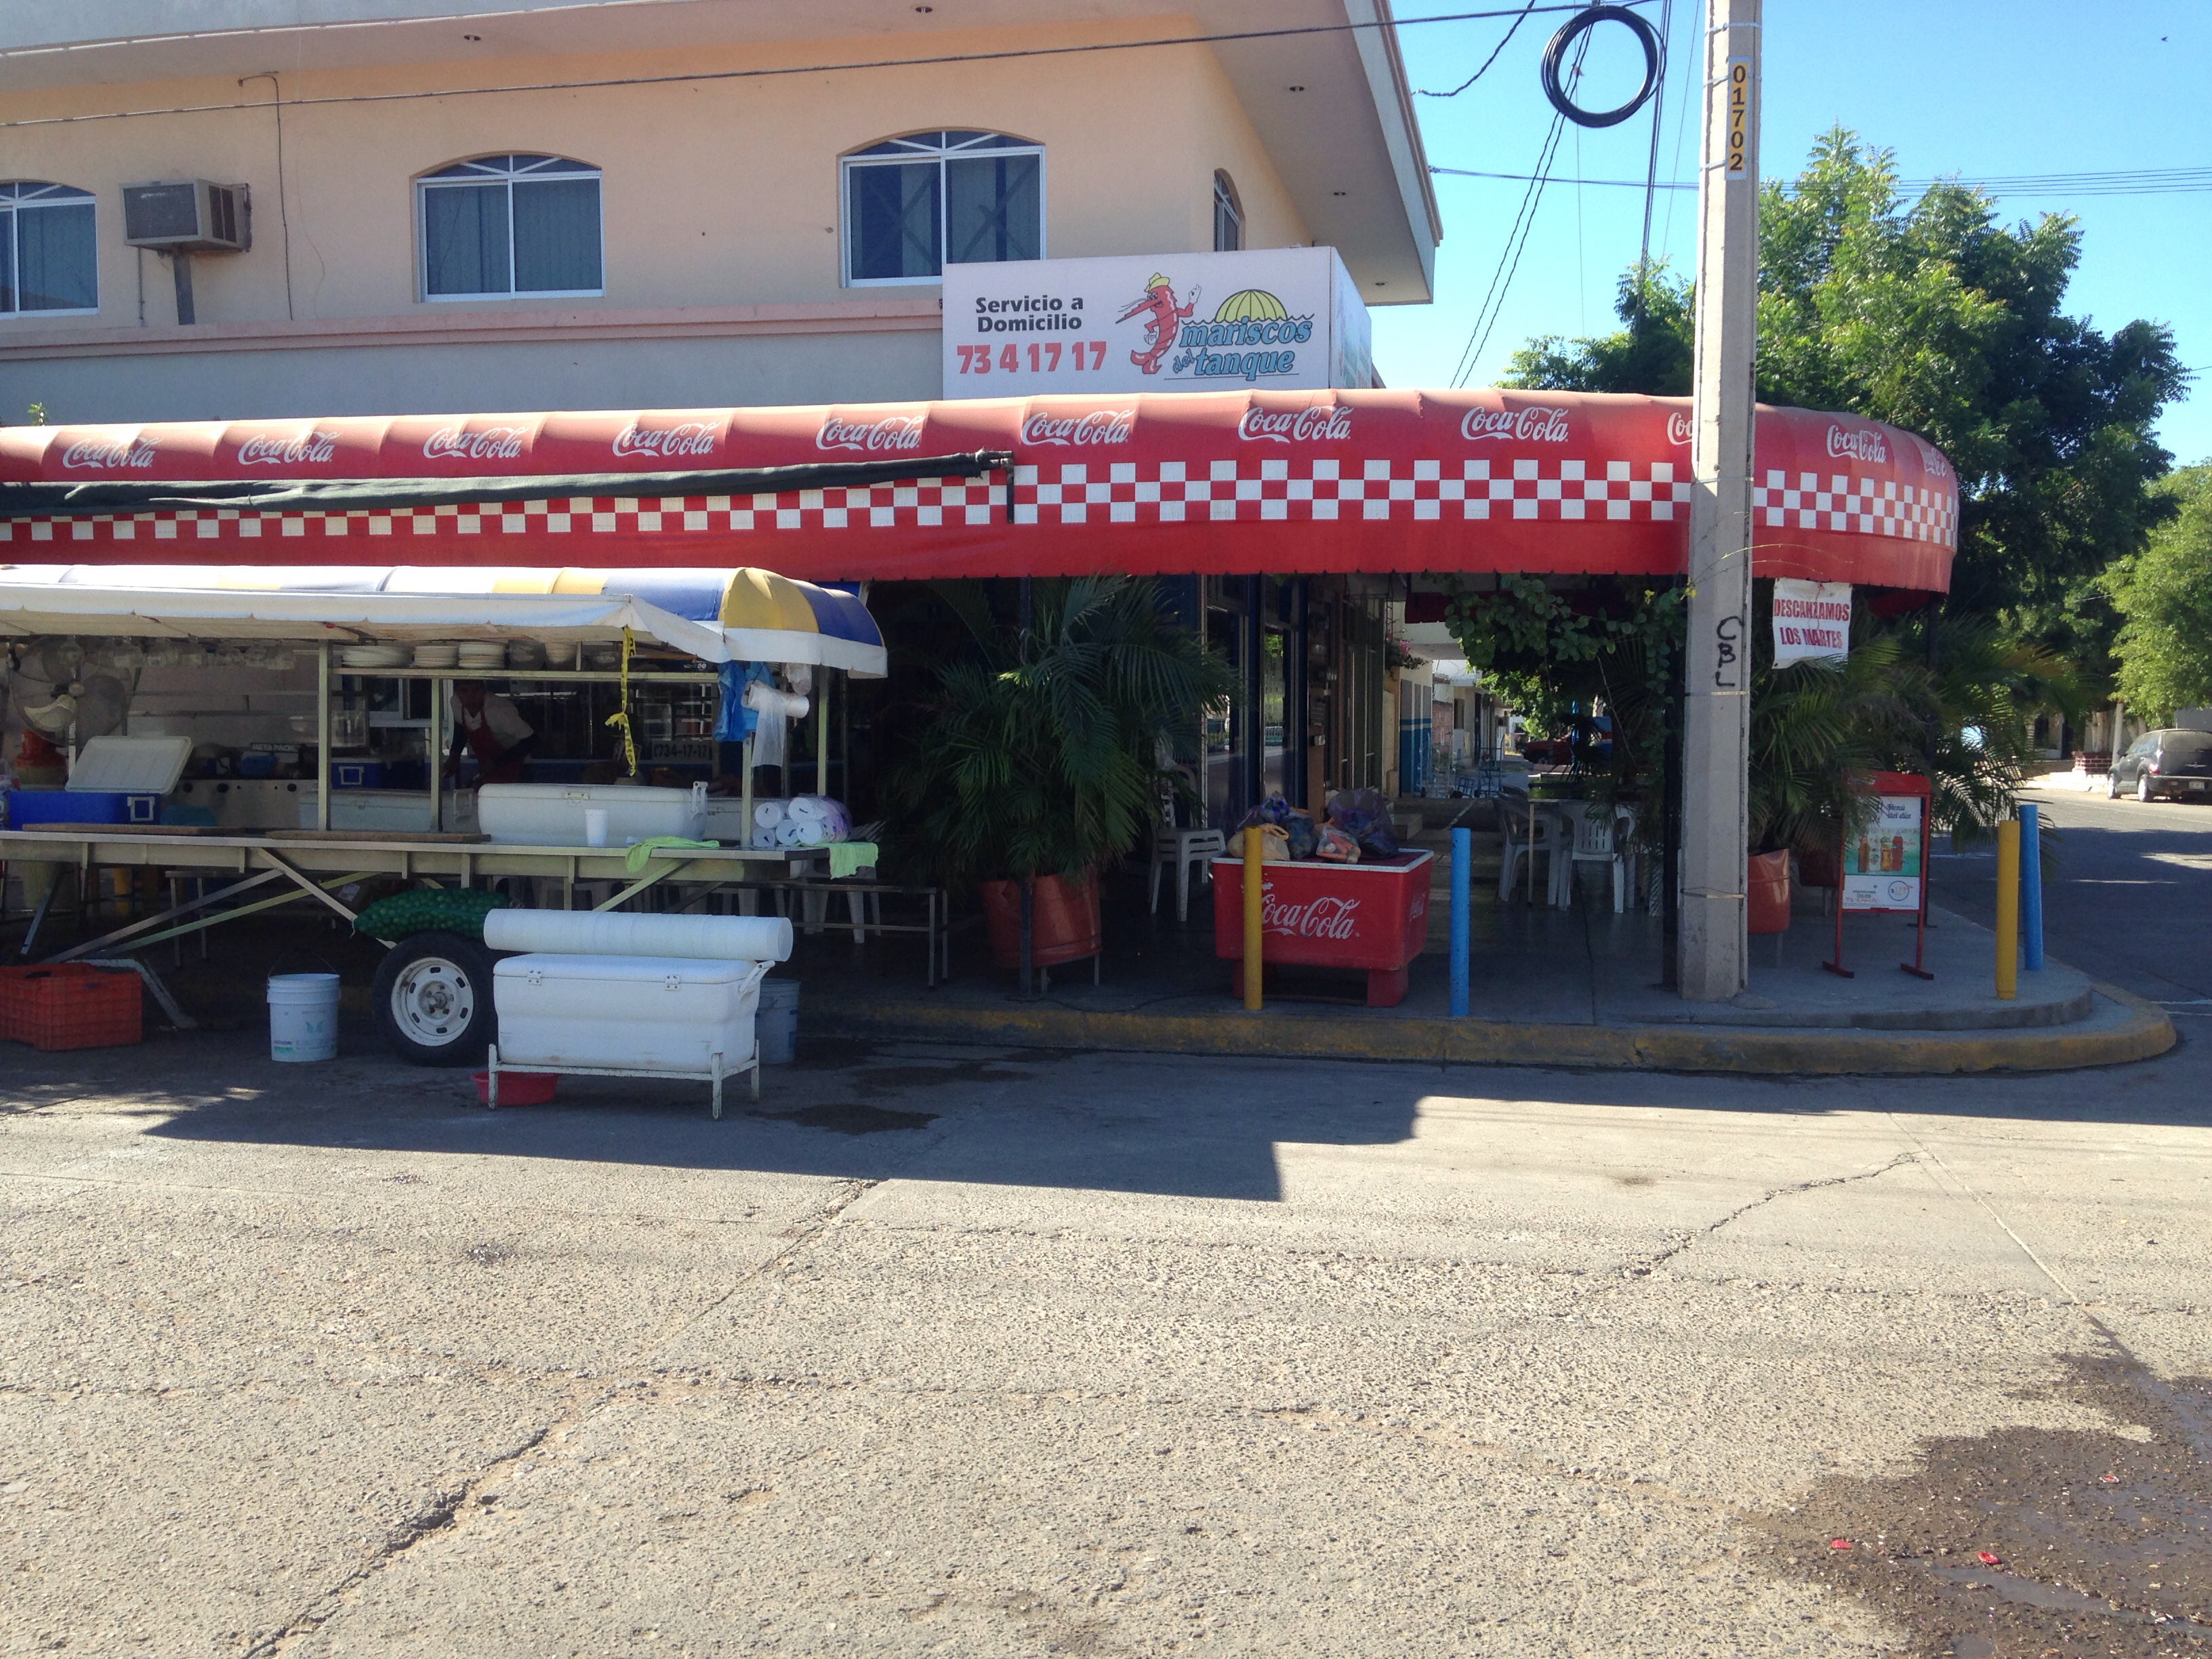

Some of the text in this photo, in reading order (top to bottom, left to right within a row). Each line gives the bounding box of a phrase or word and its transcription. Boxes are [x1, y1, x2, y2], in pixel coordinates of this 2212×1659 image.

[1729, 65, 1746, 171] 01702
[975, 294, 1084, 314] Servicio a
[977, 314, 1083, 333] Domicilio
[1179, 316, 1313, 349] mariscos
[957, 341, 1107, 374] 73 4 17 17
[1172, 349, 1295, 382] del tanque
[613, 422, 721, 457] Coca-Cola
[816, 415, 926, 451] Coca-Cola
[1021, 409, 1136, 446] Coca-Cola
[1238, 406, 1353, 443] Coca-Cola
[1462, 407, 1568, 443] Coca-Cola
[62, 437, 162, 469] Coca-Cola
[238, 431, 341, 464] Coca-Cola
[424, 427, 530, 459] Coca-Cola
[1827, 425, 1887, 464] Coca-Cola
[1774, 599, 1850, 621] DESCANZAMOS
[1780, 627, 1843, 649] LOS MARTES
